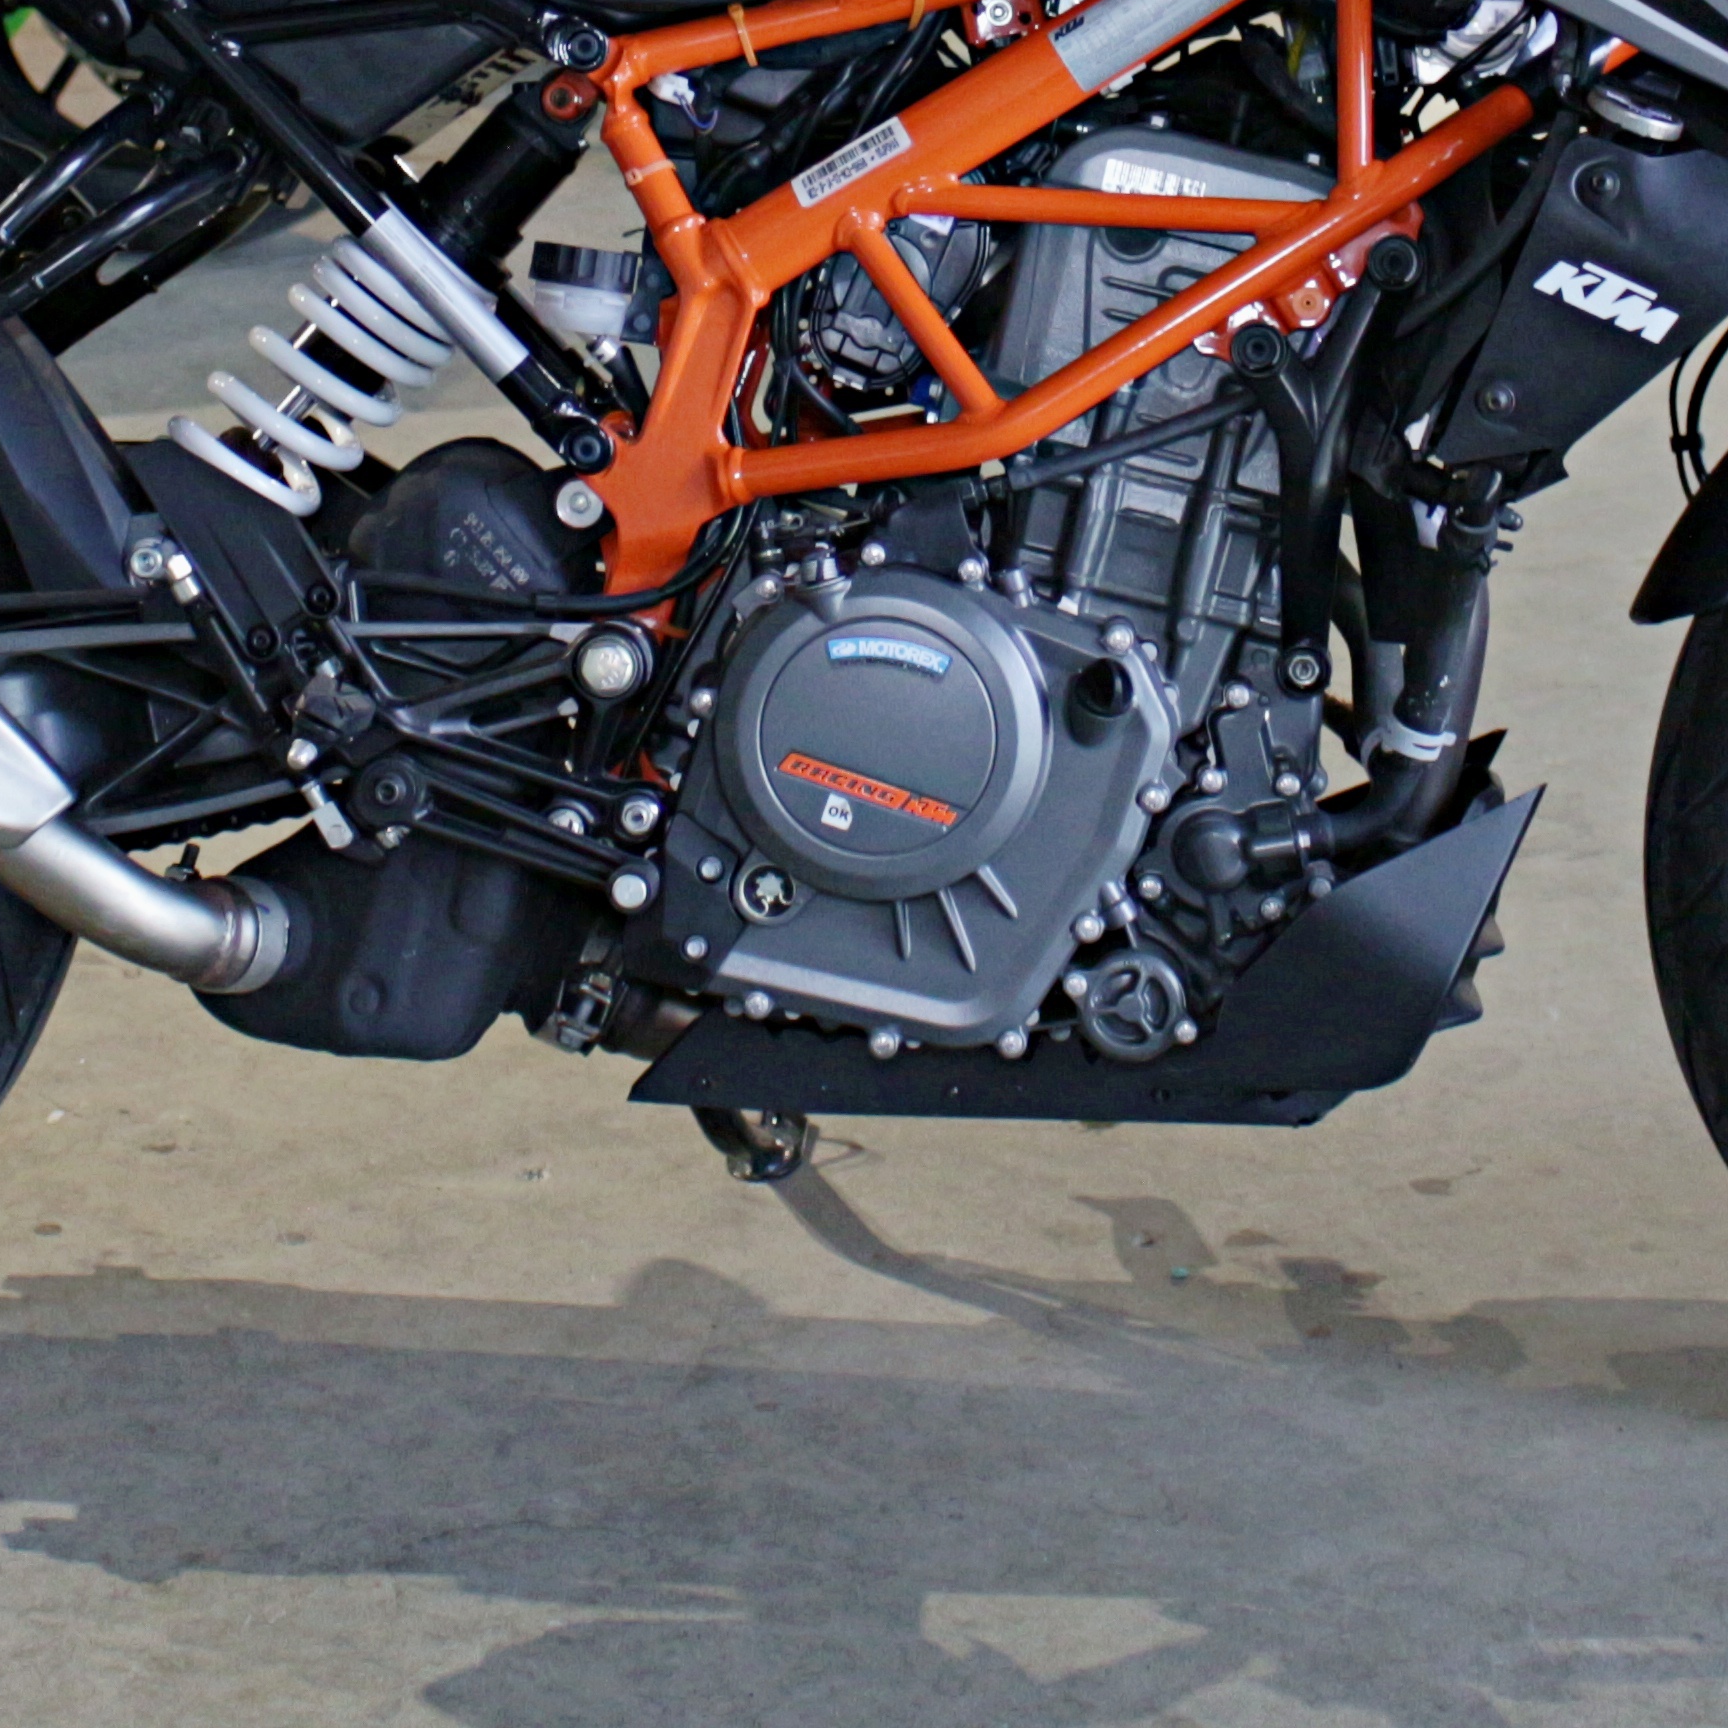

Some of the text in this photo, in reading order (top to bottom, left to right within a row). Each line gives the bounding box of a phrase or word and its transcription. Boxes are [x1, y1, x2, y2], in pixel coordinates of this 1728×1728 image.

[1054, 16, 1085, 42] KTM
[1534, 261, 1680, 344] KTM
[858, 640, 944, 671] MOTOREX
[791, 760, 896, 805] RACING
[828, 806, 849, 822] OK
